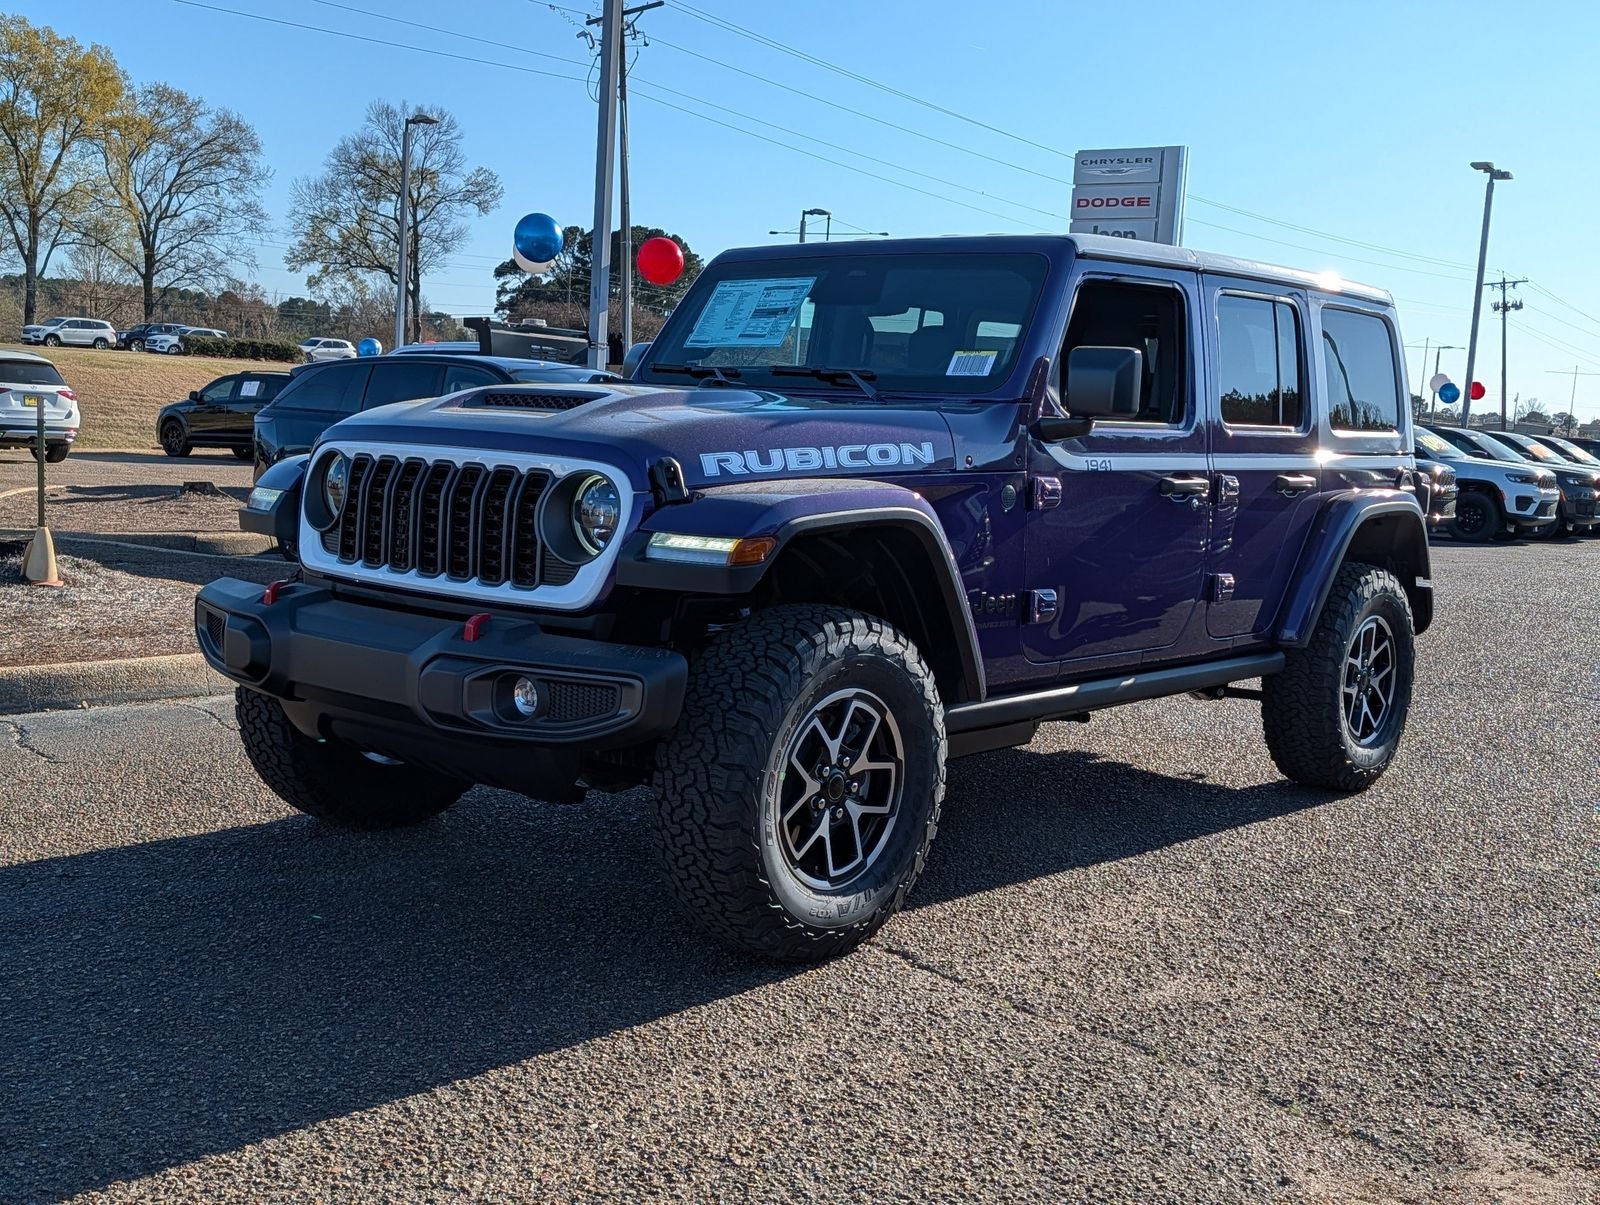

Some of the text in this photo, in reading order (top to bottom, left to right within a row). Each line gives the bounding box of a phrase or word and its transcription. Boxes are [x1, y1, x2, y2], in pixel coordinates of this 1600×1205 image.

[1080, 157, 1153, 166] CHRYSLER
[1076, 196, 1151, 208] DODGE
[699, 442, 935, 477] RUBICON
[1084, 459, 1112, 471] 1941
[973, 591, 1016, 616] Jeep
